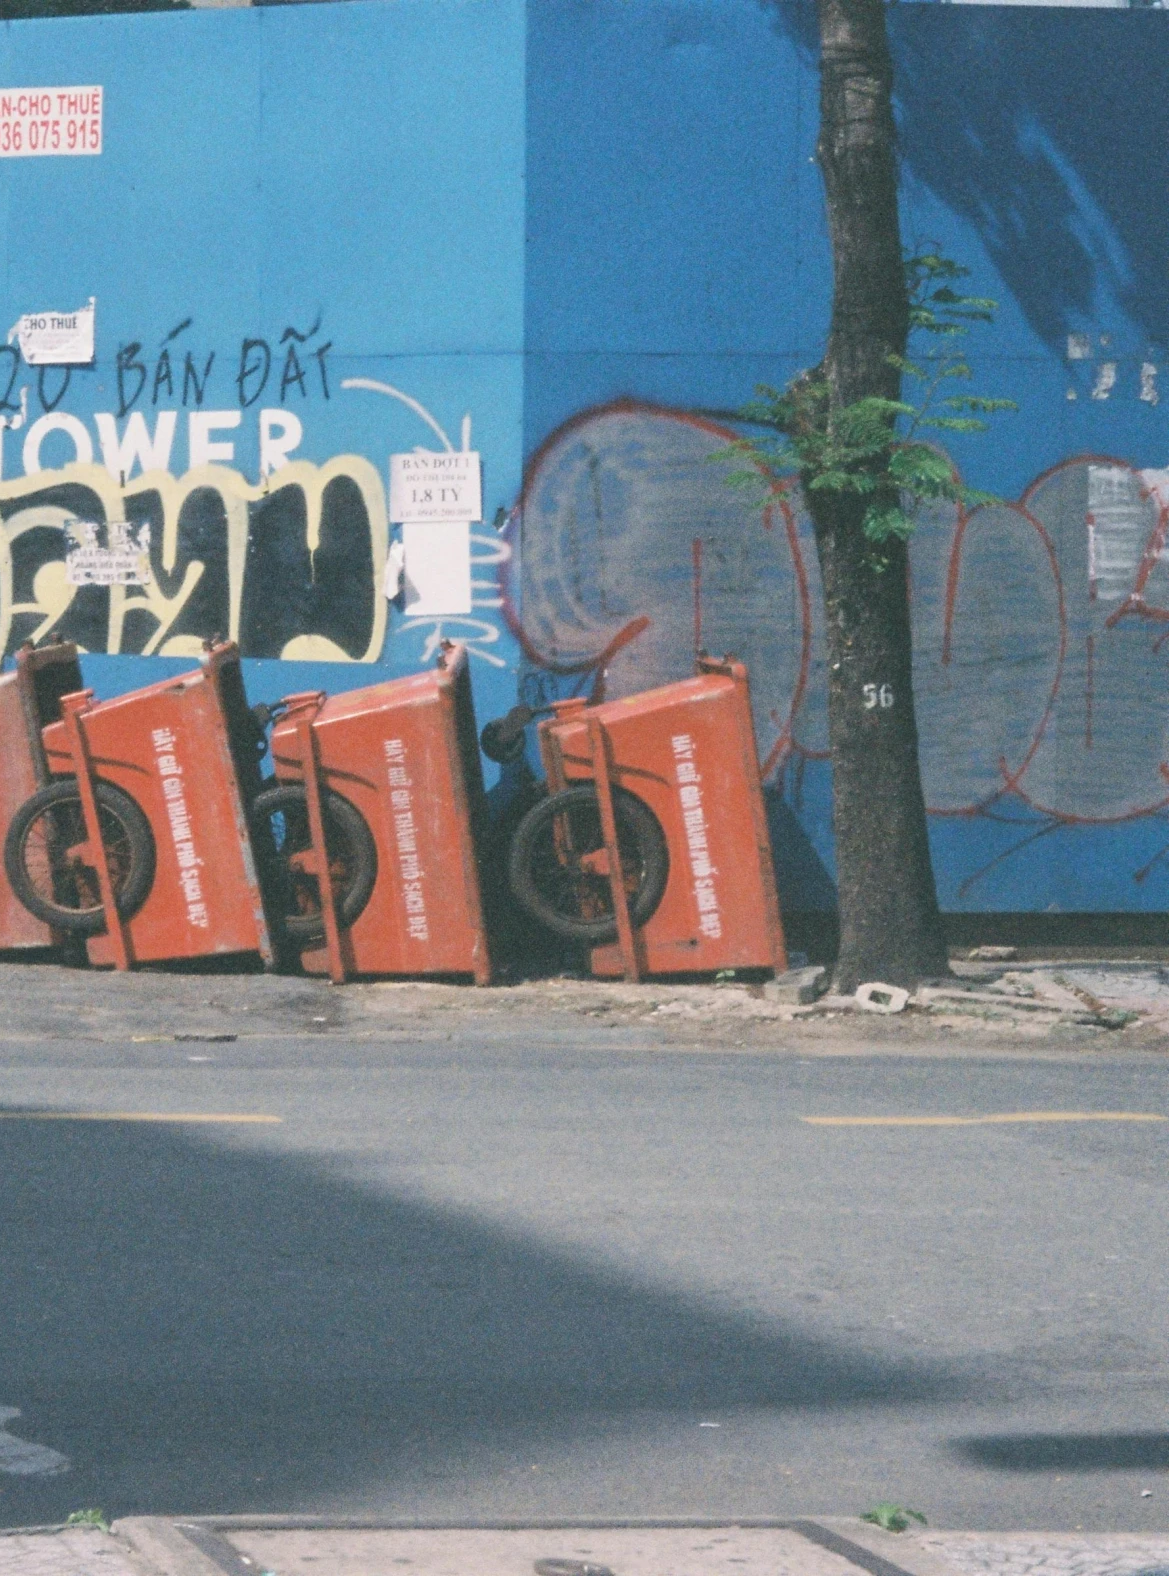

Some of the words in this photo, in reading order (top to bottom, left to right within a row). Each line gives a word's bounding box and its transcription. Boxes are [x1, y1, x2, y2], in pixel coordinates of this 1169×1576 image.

[57, 88, 100, 115] THUÊ
[29, 120, 60, 150] 075
[67, 119, 99, 149] 915
[116, 317, 215, 418] BÁN
[412, 488, 433, 503] 1,8
[863, 683, 894, 709] 56
[394, 812, 418, 852] THÀNH
[399, 854, 425, 880] PHỐ
[401, 881, 425, 913] SẠCH
